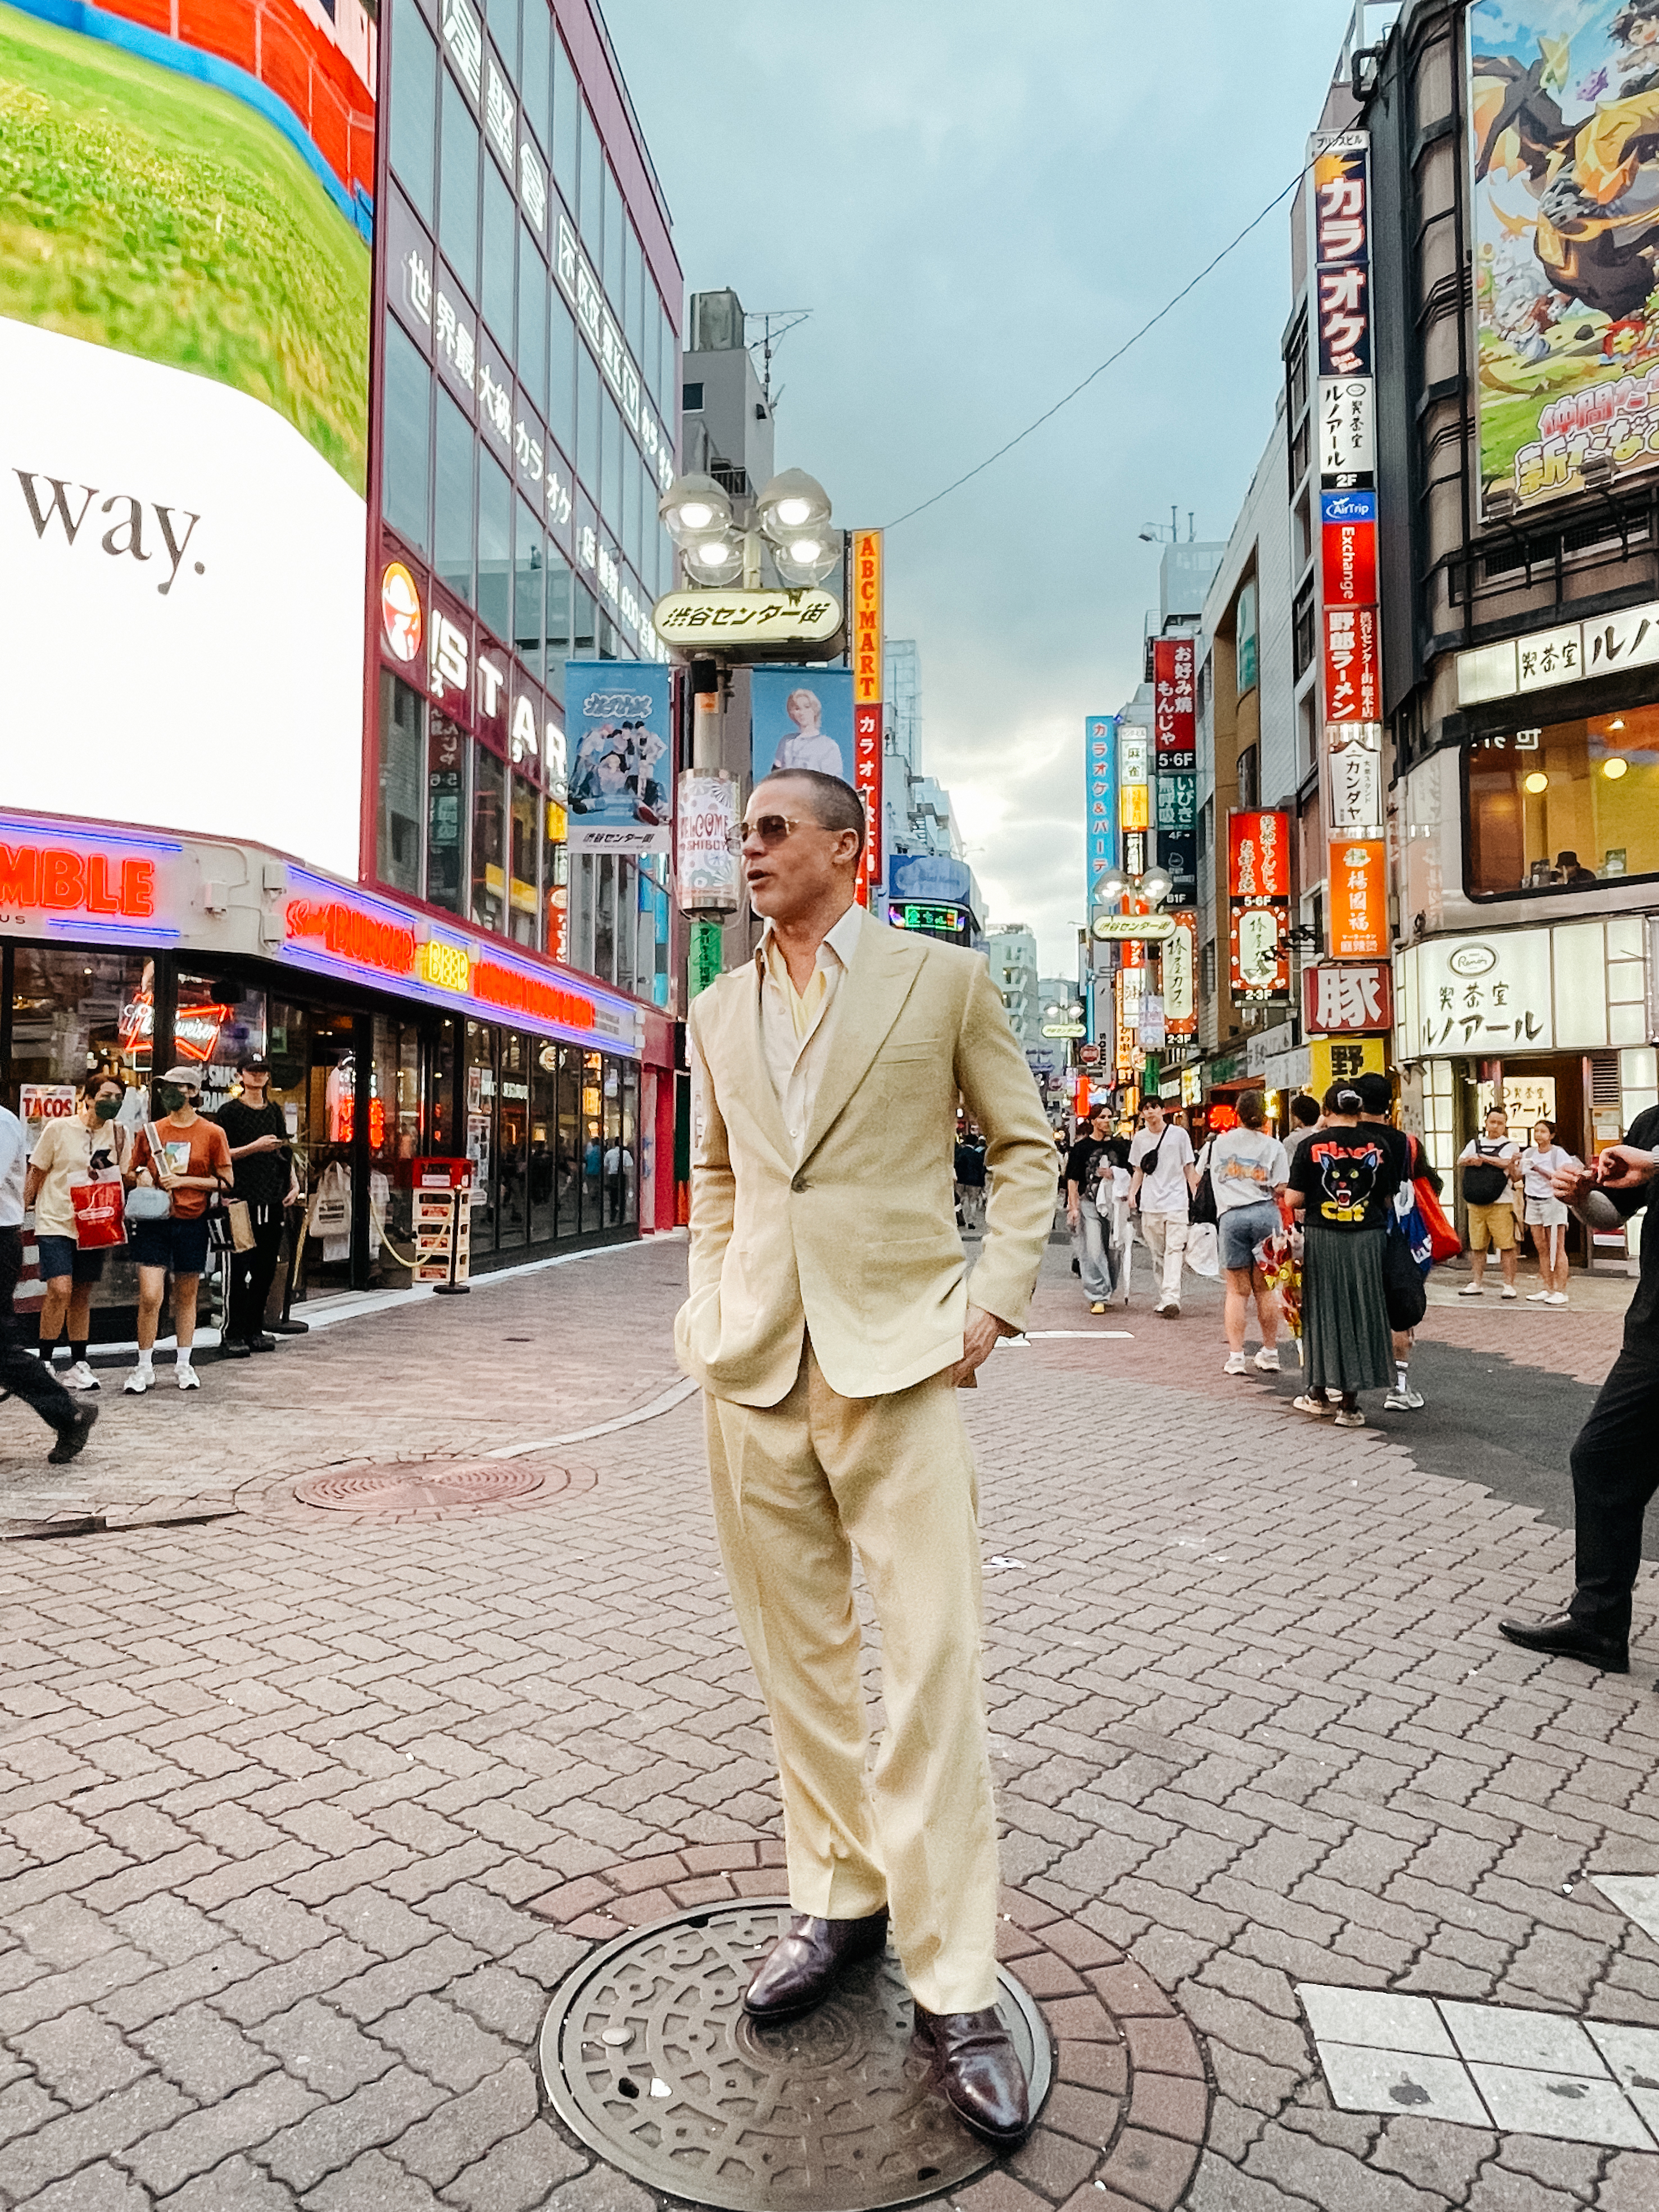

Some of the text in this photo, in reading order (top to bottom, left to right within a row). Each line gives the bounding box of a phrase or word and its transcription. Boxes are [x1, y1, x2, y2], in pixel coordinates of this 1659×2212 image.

[1321, 177, 1365, 352] カラオケ
[1326, 386, 1345, 468] ルノアール
[1350, 400, 1365, 448] 喫茶室
[1336, 474, 1357, 488] 2F
[12, 468, 205, 595] way.
[1333, 502, 1370, 515] AirTrip
[1340, 526, 1355, 600] Exchange
[662, 602, 832, 627] 渋谷センター街
[1329, 611, 1356, 719] 野郎ラーメン
[1522, 618, 1659, 679] 喫茶室 ルノ
[1174, 646, 1193, 714] お好み焼
[1157, 681, 1176, 746] もんじゃ
[1093, 723, 1108, 871] カラオケ&パーテ
[1177, 776, 1195, 823] いびき
[1346, 760, 1361, 821] カンダヤ
[686, 840, 729, 851] SHIBUY
[1168, 831, 1182, 840] 4F
[429, 940, 469, 992] BEER
[1316, 968, 1382, 1028] 豚
[1439, 980, 1510, 1012] 喫茶室
[1422, 1010, 1544, 1046] ルノアール
[1331, 1045, 1364, 1077] 野
[22, 1098, 72, 1117] TACOS
